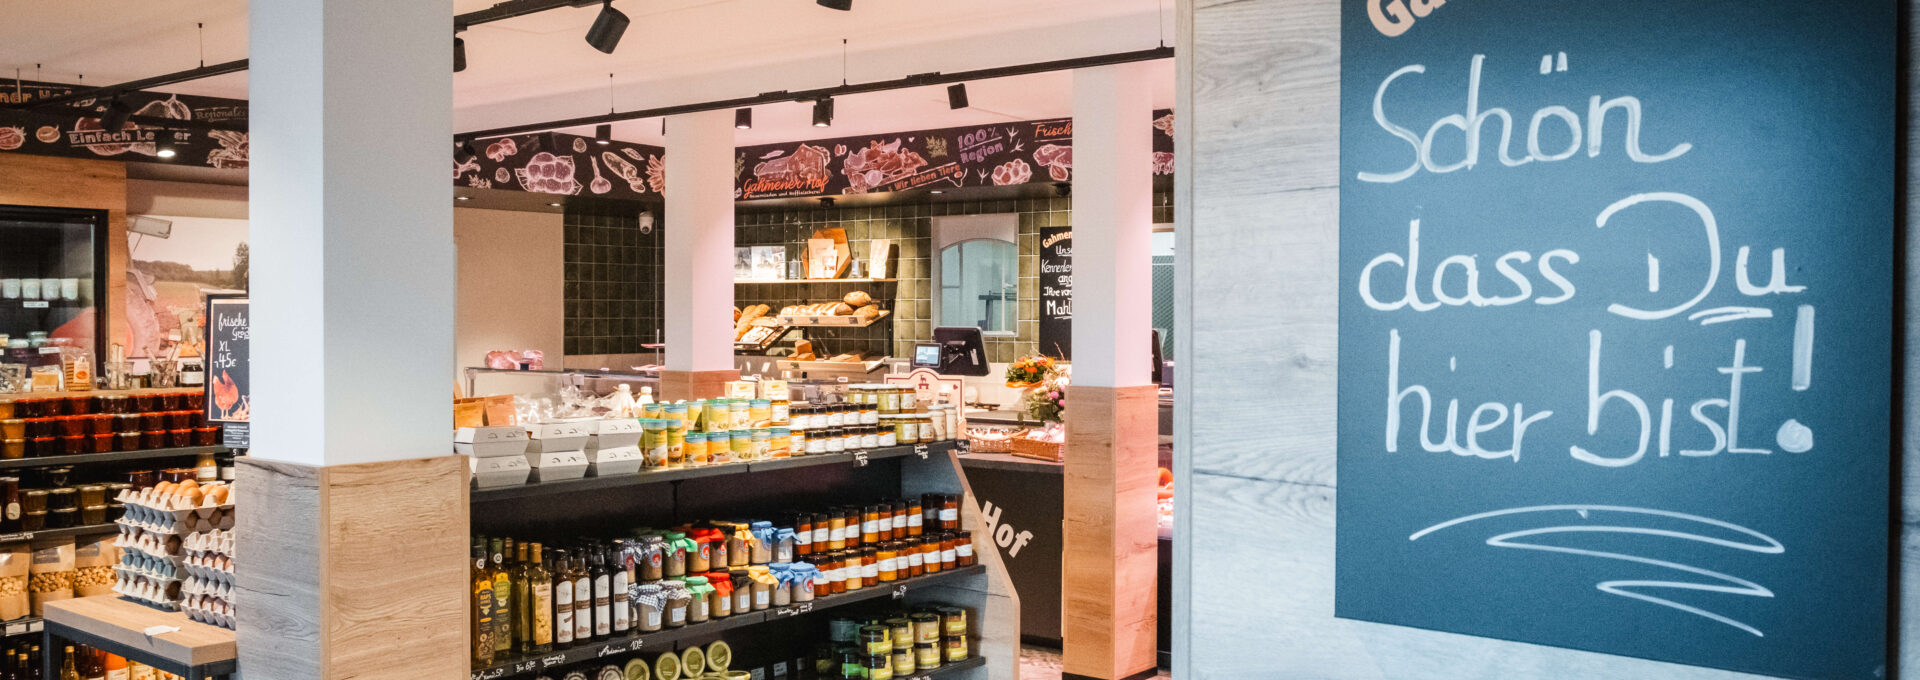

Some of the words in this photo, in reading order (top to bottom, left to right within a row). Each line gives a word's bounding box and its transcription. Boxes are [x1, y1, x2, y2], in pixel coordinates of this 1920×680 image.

[1357, 51, 1693, 183] Schön
[69, 130, 131, 144] Einfach
[136, 130, 192, 141] Leer
[960, 142, 1004, 164] Region
[743, 178, 804, 199] Gahmener
[805, 175, 829, 193] Hof
[894, 178, 909, 190] Wir
[910, 170, 937, 185] lieben
[938, 163, 961, 177] Tiere
[1358, 210, 1580, 313] dass
[1594, 192, 1808, 321] Du
[218, 312, 248, 332] frische
[218, 340, 232, 352] XL
[1384, 329, 1554, 463] hier
[1570, 304, 1816, 468] bist!
[982, 500, 1034, 559] Hof
